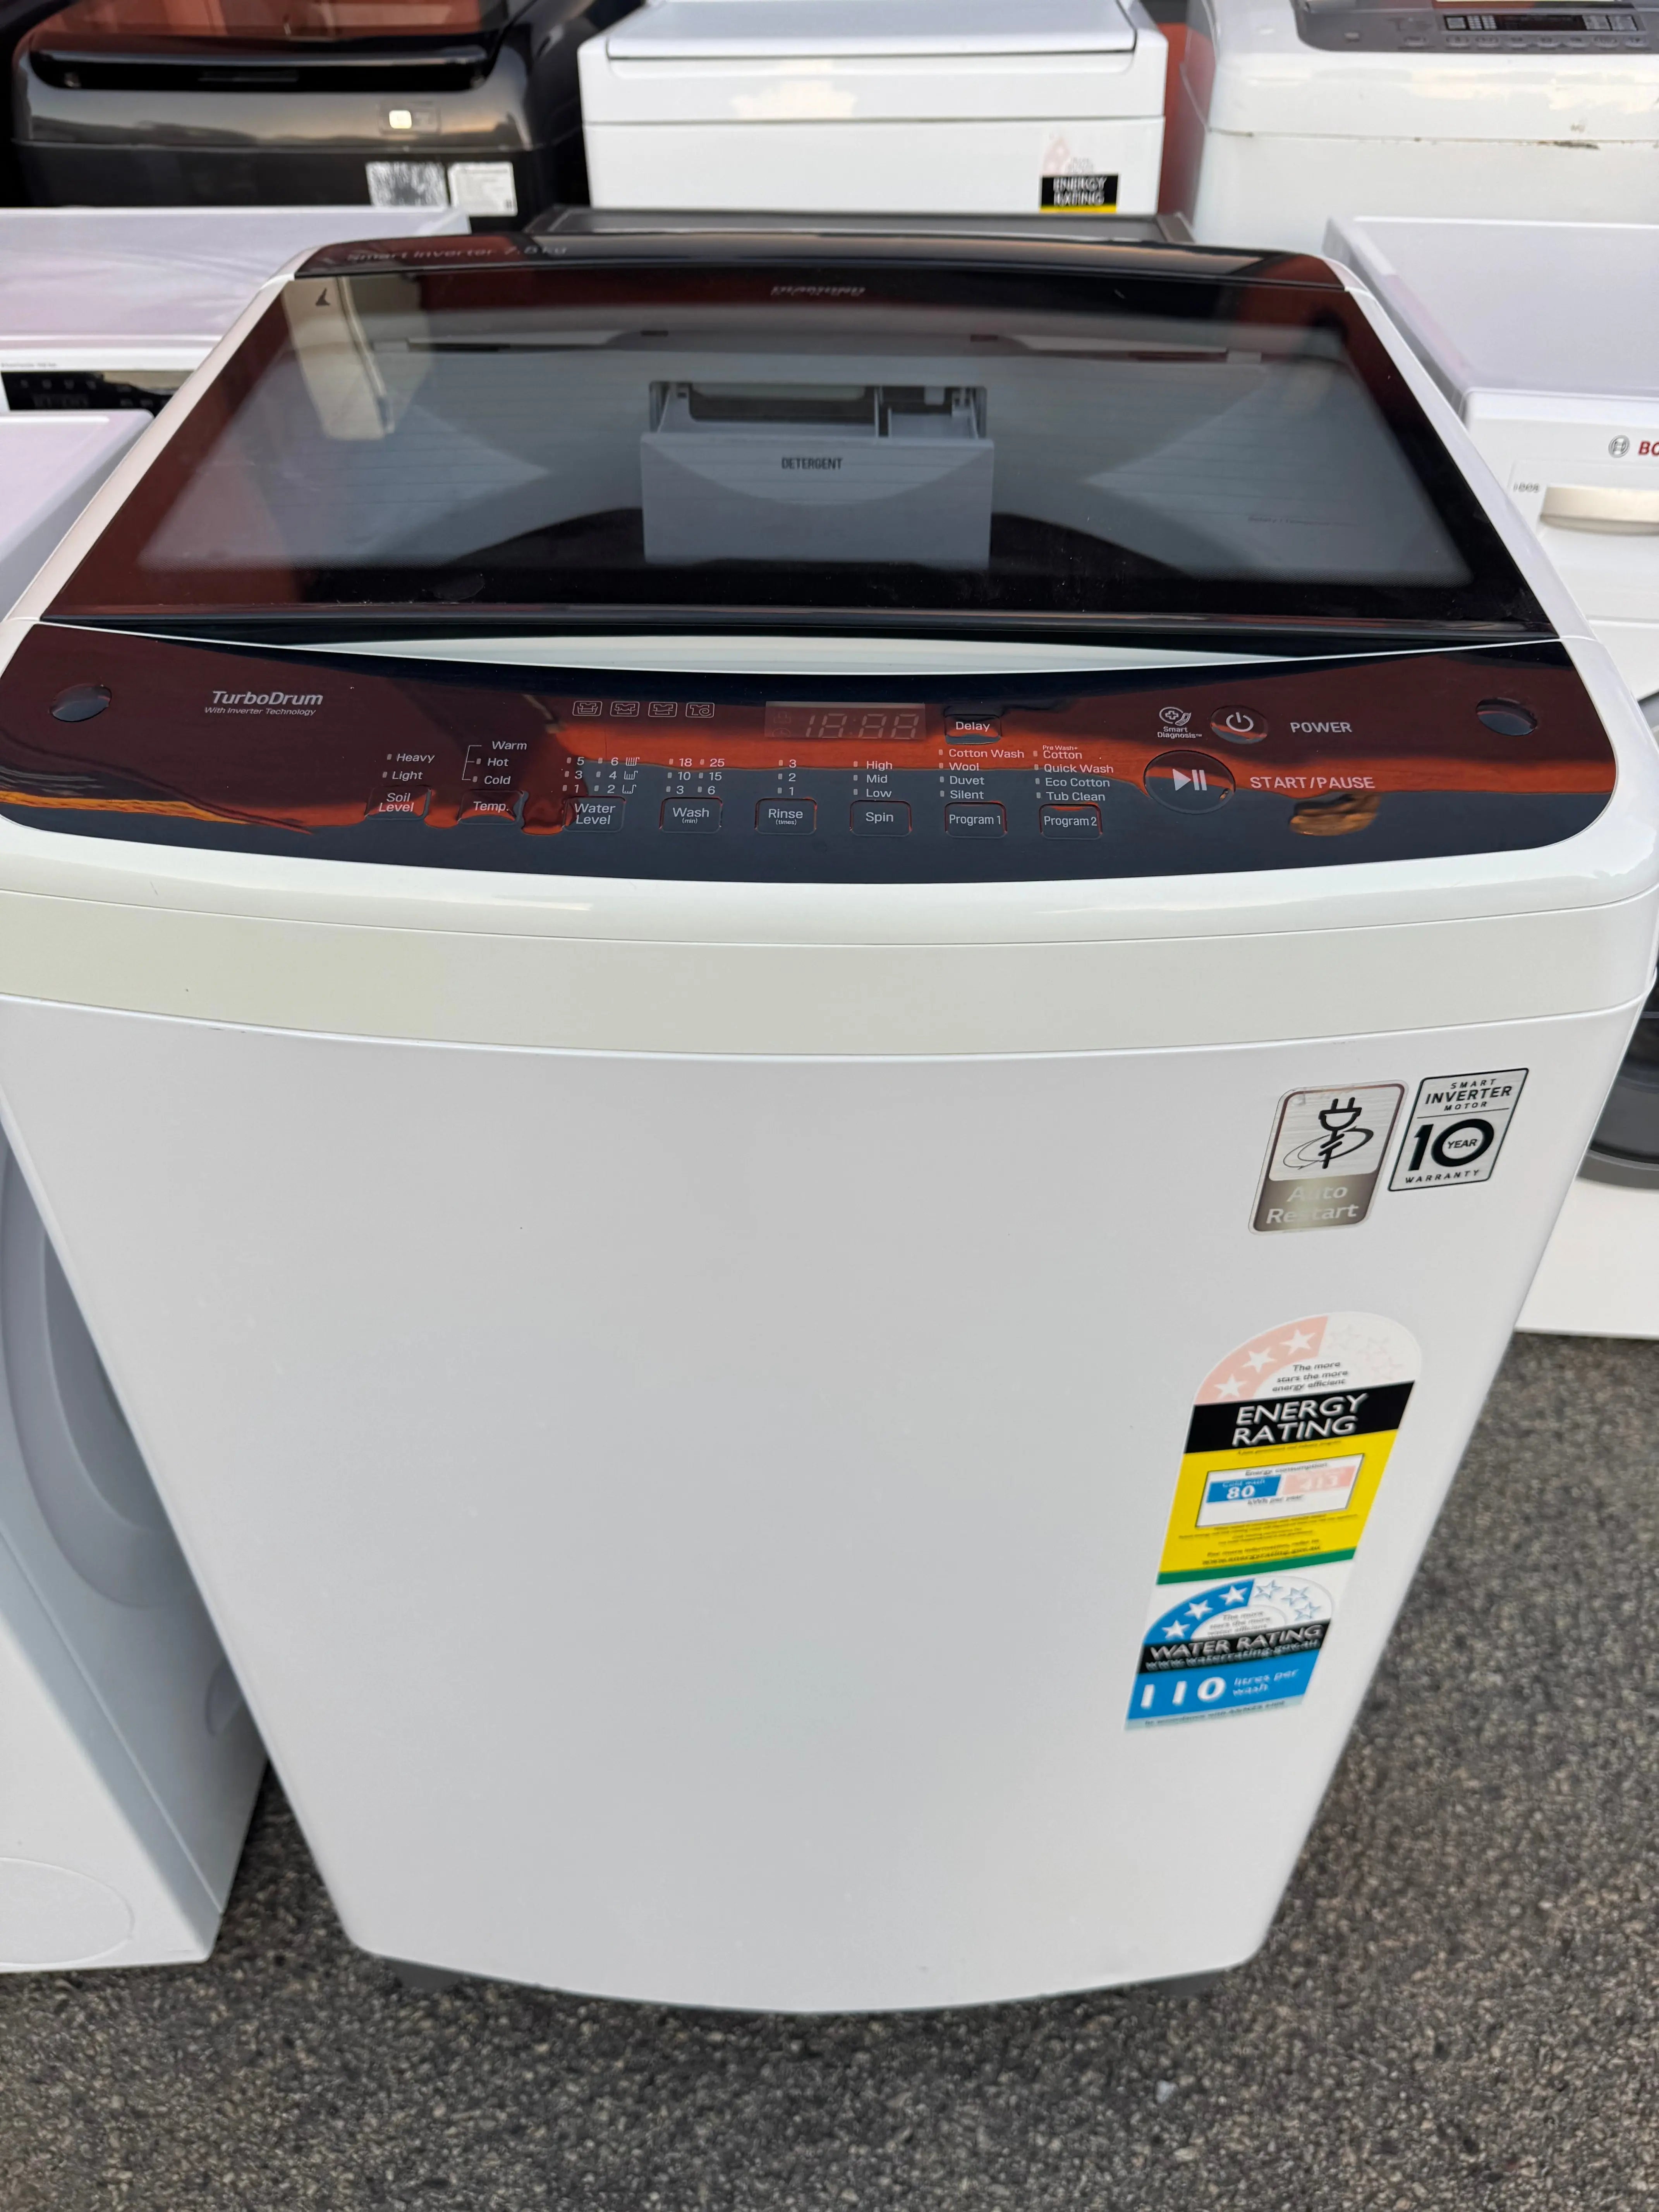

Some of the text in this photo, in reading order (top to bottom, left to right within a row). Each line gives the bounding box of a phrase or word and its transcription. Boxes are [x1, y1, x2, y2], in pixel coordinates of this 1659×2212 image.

[781, 458, 842, 470] DETERGENT
[213, 690, 323, 705] TurboDrum
[956, 721, 990, 732] Delay
[1290, 722, 1352, 733] POWER
[492, 741, 527, 750] Warm
[397, 753, 435, 764] Heavy
[949, 749, 1024, 758] Cotton Wash
[1043, 750, 1082, 760] Cotton
[488, 758, 508, 767] Hot
[577, 757, 619, 766] 5 6
[679, 758, 725, 768] 18 25
[789, 759, 797, 768] 3
[866, 761, 893, 771] High
[949, 762, 979, 771] Wool
[1044, 764, 1114, 774] Quick Wash
[392, 770, 423, 781] Light
[575, 771, 617, 779] 3 4
[678, 771, 722, 781] 10 15
[788, 773, 796, 782] 2
[866, 774, 888, 784] Mid
[484, 776, 511, 785] Cold
[950, 776, 985, 785] Duvet
[1046, 778, 1110, 788] Eco Cotton
[1250, 777, 1375, 789] START/PAUSE
[575, 785, 615, 793] 1 2
[676, 785, 716, 795] 3 6
[789, 787, 794, 796] 1
[866, 788, 892, 798] Low
[386, 792, 410, 803] Soil
[950, 790, 984, 800] Silent
[1046, 792, 1106, 802] Tub Clean
[379, 802, 414, 813] Level
[473, 801, 509, 813] Temp.
[575, 804, 615, 814] Water
[673, 807, 709, 818] Wash
[769, 808, 803, 819] Rinse
[866, 811, 894, 824] Spin
[576, 814, 611, 825] Level
[949, 814, 1001, 826] Program 1
[1044, 815, 1097, 828] Program 2
[1450, 1079, 1497, 1089] SMART
[1425, 1085, 1512, 1104] INVERTER
[1444, 1101, 1488, 1111] MOTOR
[1408, 1118, 1494, 1171] 10
[1446, 1139, 1477, 1149] YEAR
[1405, 1169, 1480, 1184] WARRANTY
[1314, 1362, 1341, 1370] more
[1272, 1383, 1305, 1391] energy
[1236, 1393, 1369, 1426] ENERGY
[1232, 1415, 1358, 1448] RATING
[1226, 1485, 1255, 1499] 80
[1150, 1625, 1324, 1661] WATER RATING
[1234, 1669, 1300, 1686] litres per
[1233, 1684, 1269, 1696] wash
